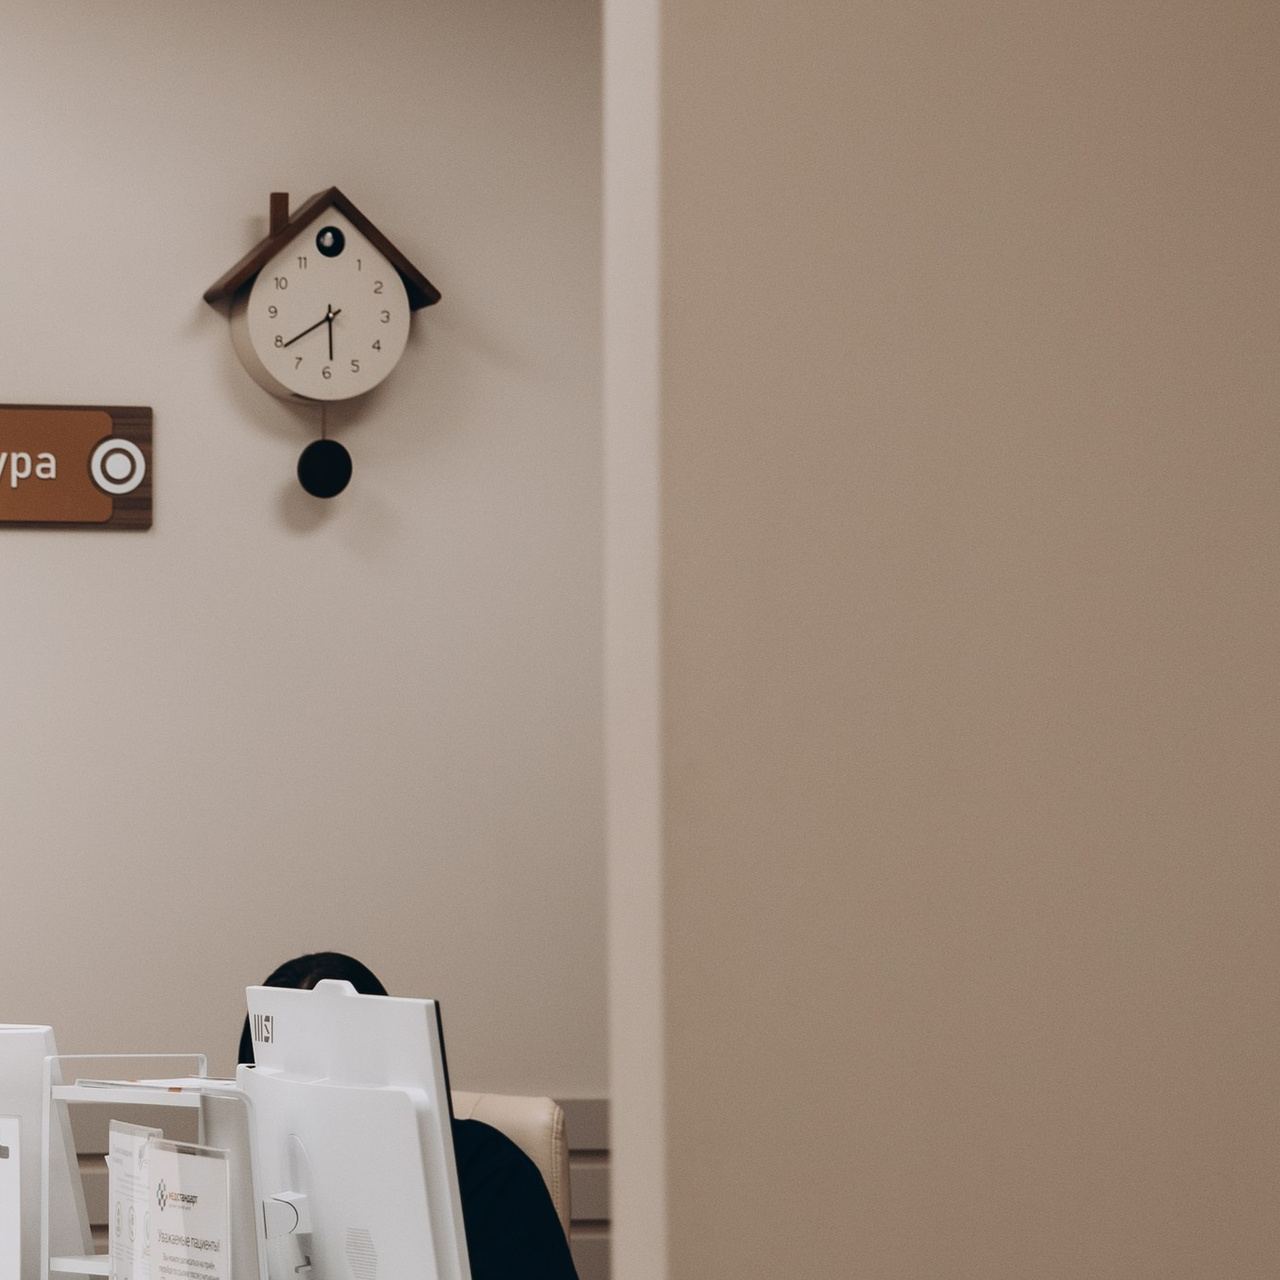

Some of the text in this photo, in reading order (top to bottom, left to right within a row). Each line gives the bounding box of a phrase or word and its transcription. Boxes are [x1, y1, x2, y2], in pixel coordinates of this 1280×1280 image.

[297, 256, 308, 269] 11
[356, 259, 362, 271] 1
[274, 277, 288, 290] 10
[373, 281, 384, 295] 2
[268, 306, 278, 318] 9
[380, 310, 391, 324] 3
[274, 335, 284, 348] 8
[372, 339, 381, 352] 4
[294, 357, 303, 370] 7
[350, 360, 360, 373] 5
[322, 366, 332, 379] 6
